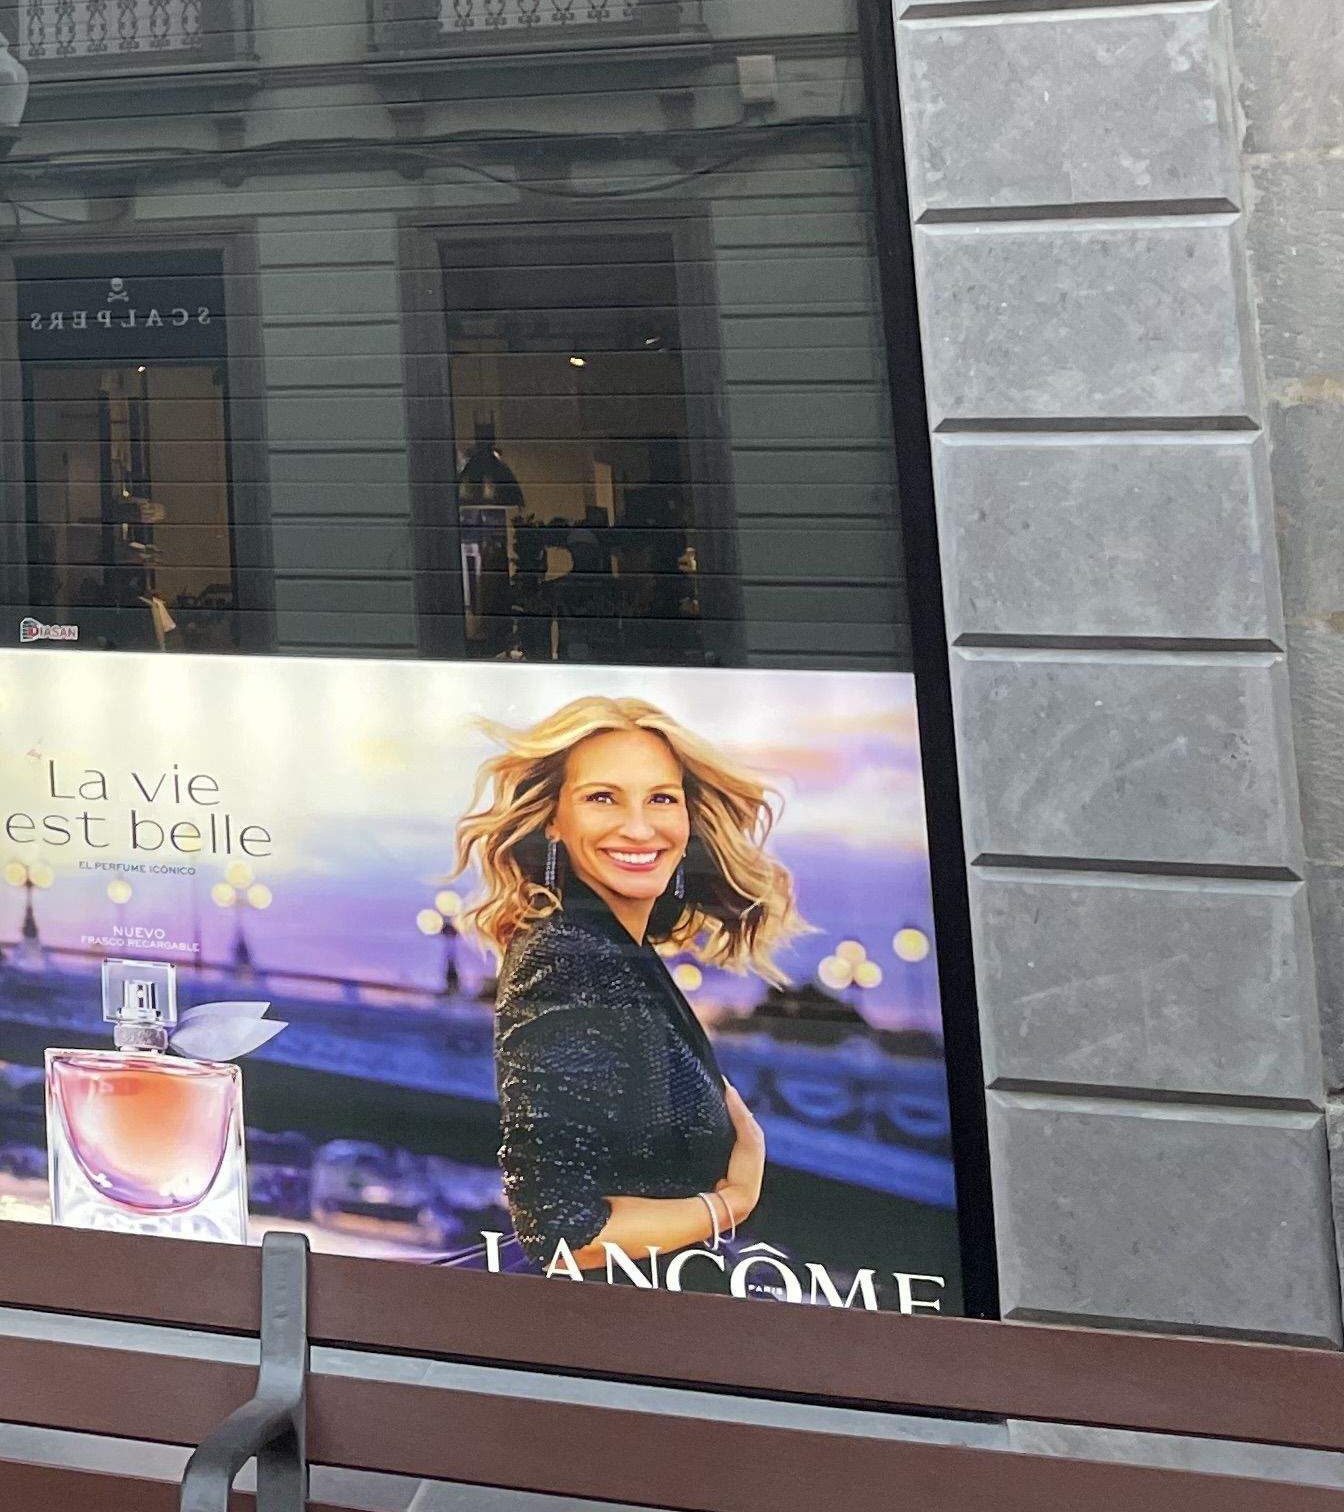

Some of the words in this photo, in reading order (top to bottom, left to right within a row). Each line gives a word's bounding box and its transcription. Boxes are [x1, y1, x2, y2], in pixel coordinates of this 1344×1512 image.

[49, 759, 109, 801] La
[131, 764, 220, 806] vie
[6, 811, 110, 848] est
[131, 809, 272, 857] belle
[79, 861, 92, 870] EL
[94, 862, 147, 874] PERFUME
[113, 925, 166, 940] NUEVO
[81, 935, 125, 946] FRASCO
